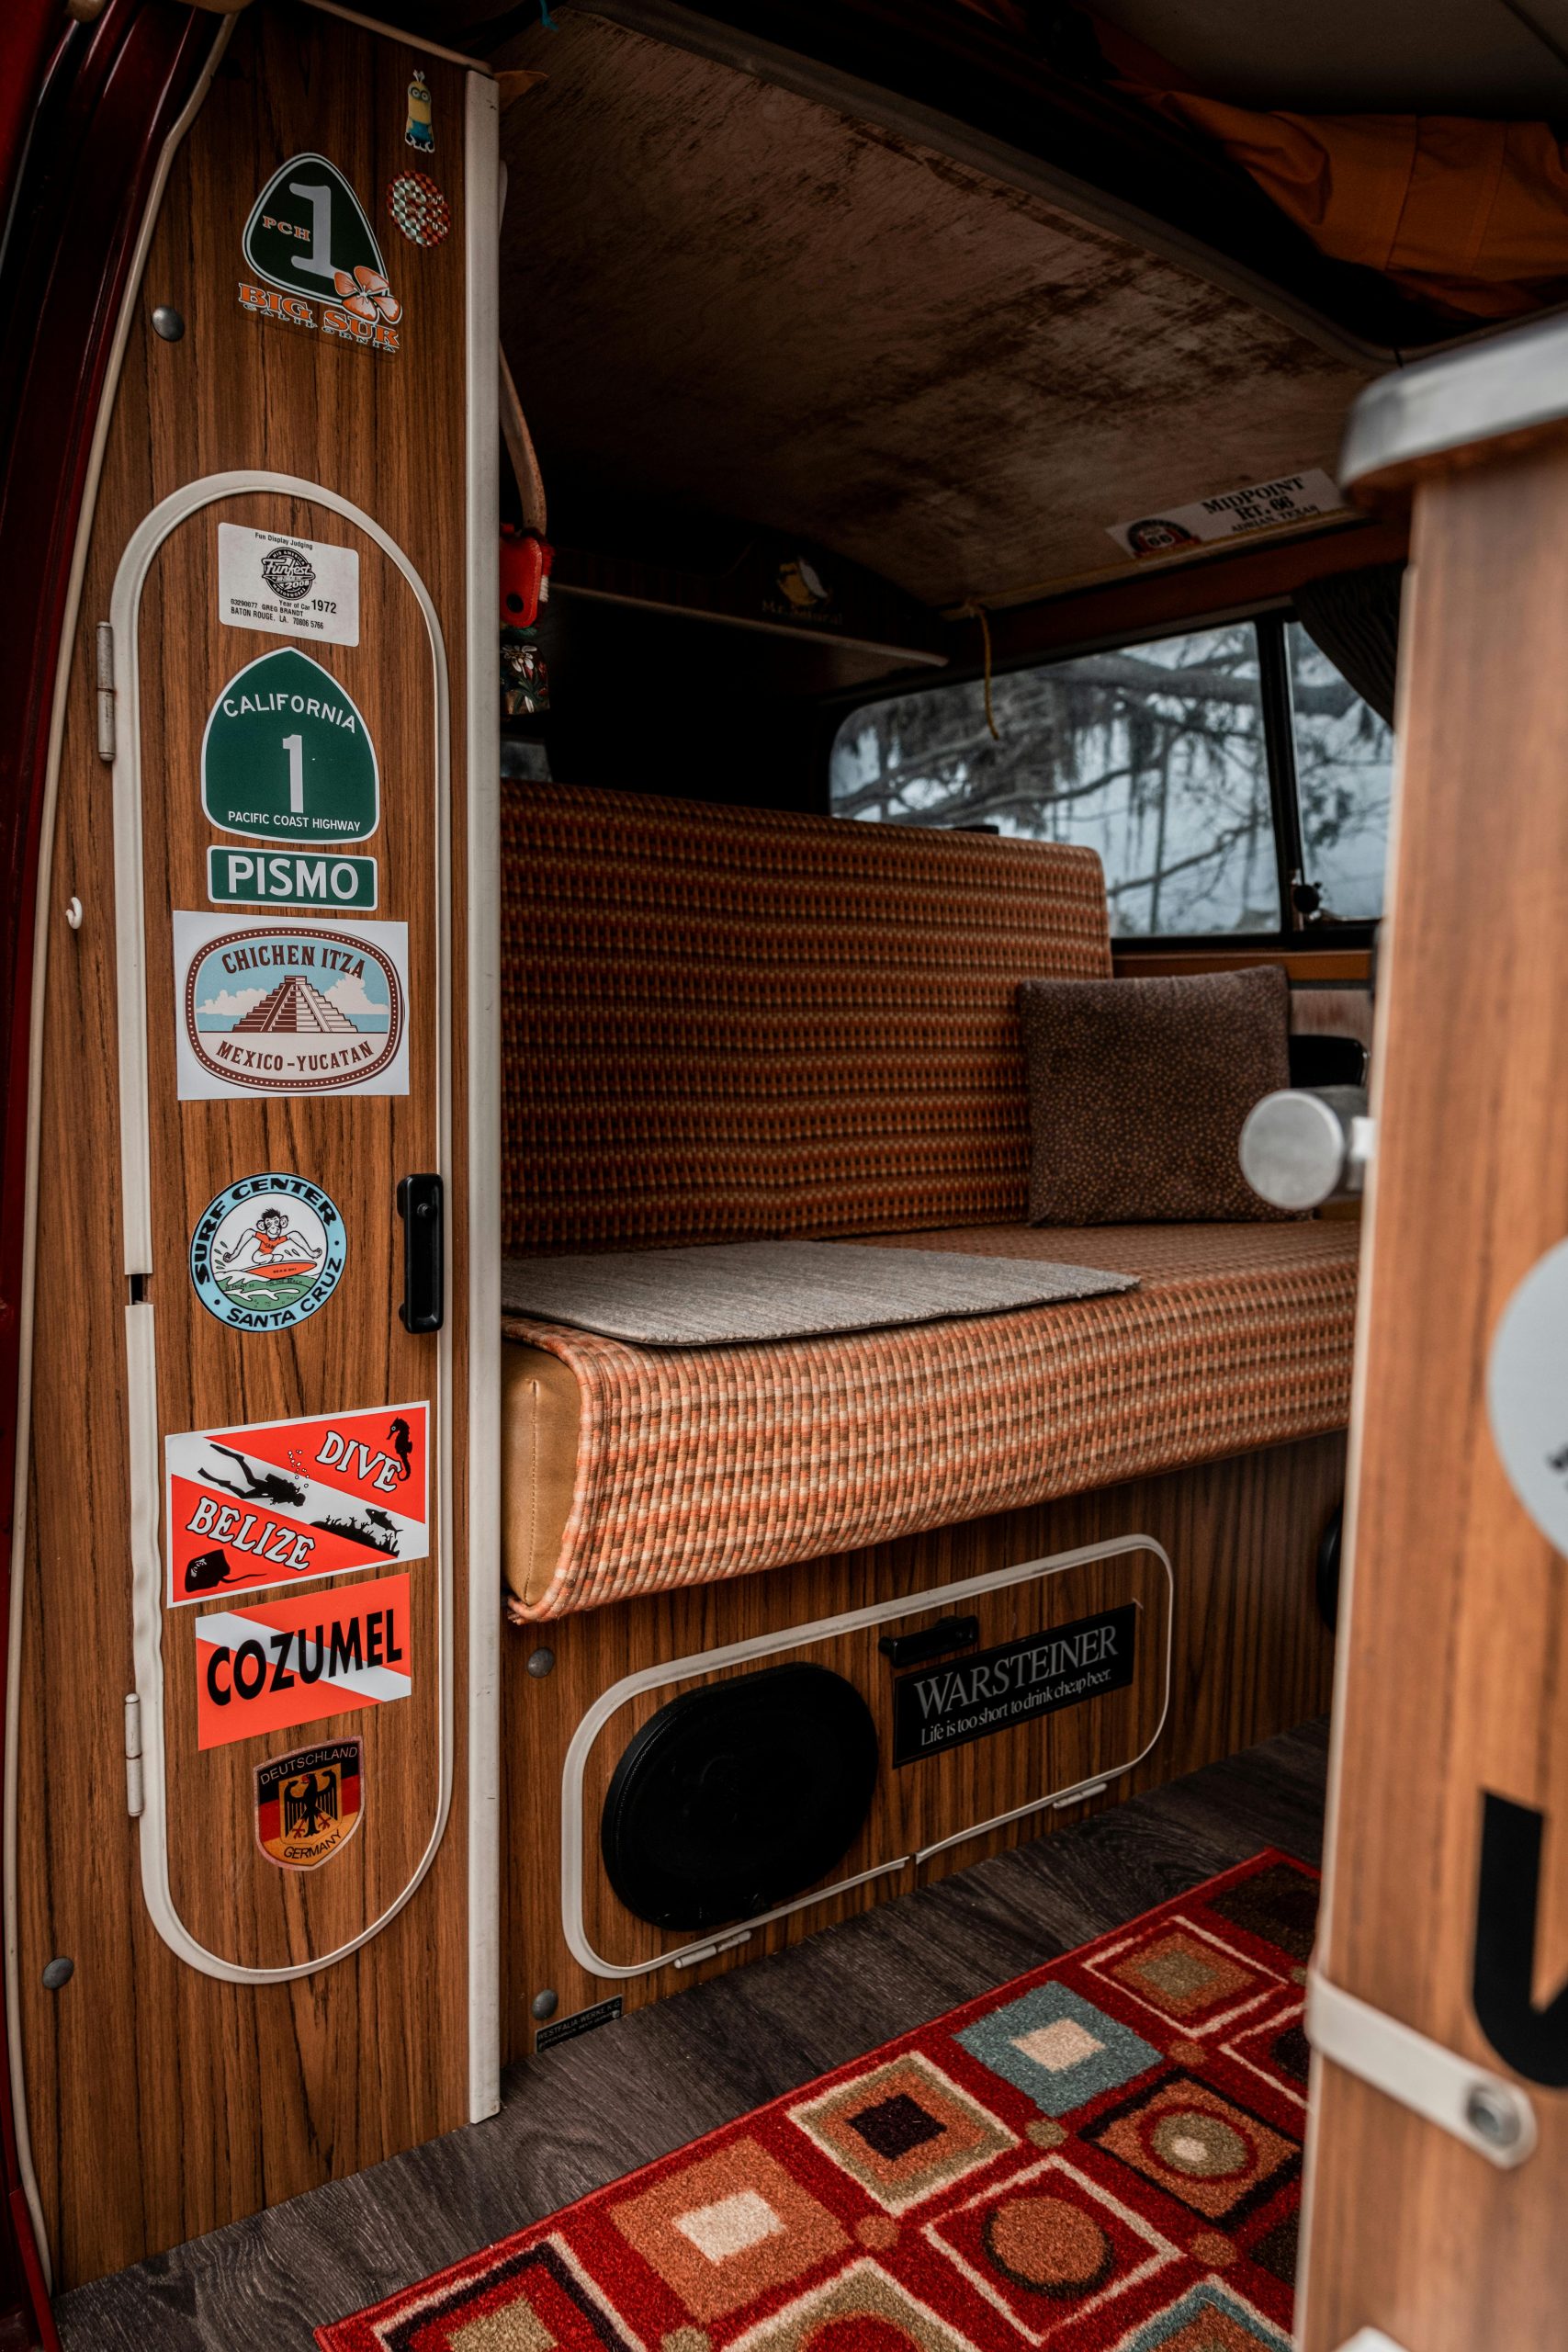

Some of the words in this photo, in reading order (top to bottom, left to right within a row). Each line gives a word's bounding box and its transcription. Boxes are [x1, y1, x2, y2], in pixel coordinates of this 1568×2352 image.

[262, 215, 310, 242] PCH
[289, 183, 336, 278] 1
[238, 282, 312, 321] BIG
[323, 310, 400, 347] SUR
[243, 303, 396, 353] CALIFORNIA
[1201, 476, 1304, 514] MIDPOINT
[1235, 503, 1271, 521] RT.
[1269, 495, 1295, 511] 66
[255, 532, 266, 540] Fun
[268, 535, 289, 546] Display
[290, 539, 313, 550] Judging
[262, 558, 314, 577] Funfest
[231, 606, 251, 616] BATON
[293, 617, 310, 628] 70806
[279, 599, 292, 607] Year
[300, 603, 310, 611] Car
[311, 598, 337, 615] 1972
[280, 606, 303, 616] BRANDT
[223, 693, 356, 733] CALIFORNIA
[282, 734, 304, 814] 1
[228, 810, 270, 825] PACIFIC
[273, 814, 310, 828] COAST
[312, 818, 361, 832] HIGHWAY
[228, 854, 359, 900] PISMO
[221, 944, 316, 974] CHICHEN
[321, 948, 366, 980] ITZA
[195, 1200, 227, 1285] SURF
[231, 1178, 337, 1227] CENTER
[226, 1307, 297, 1328] SANTA
[300, 1257, 343, 1312] CRUZ
[315, 1430, 403, 1492] DIVE
[186, 1496, 315, 1571] BELIZE
[207, 1608, 402, 1706] COZUMEL
[914, 1625, 1119, 1720] WARSTEINER
[921, 1721, 944, 1746] Life
[946, 1719, 956, 1737] is
[958, 1714, 977, 1733] too
[979, 1702, 1009, 1724] short
[1010, 1700, 1022, 1714] to
[1023, 1686, 1054, 1709] drink
[1055, 1678, 1086, 1699] cheap
[259, 1746, 359, 1786] DEUTSCHLAND
[284, 1830, 343, 1860] GERMANY
